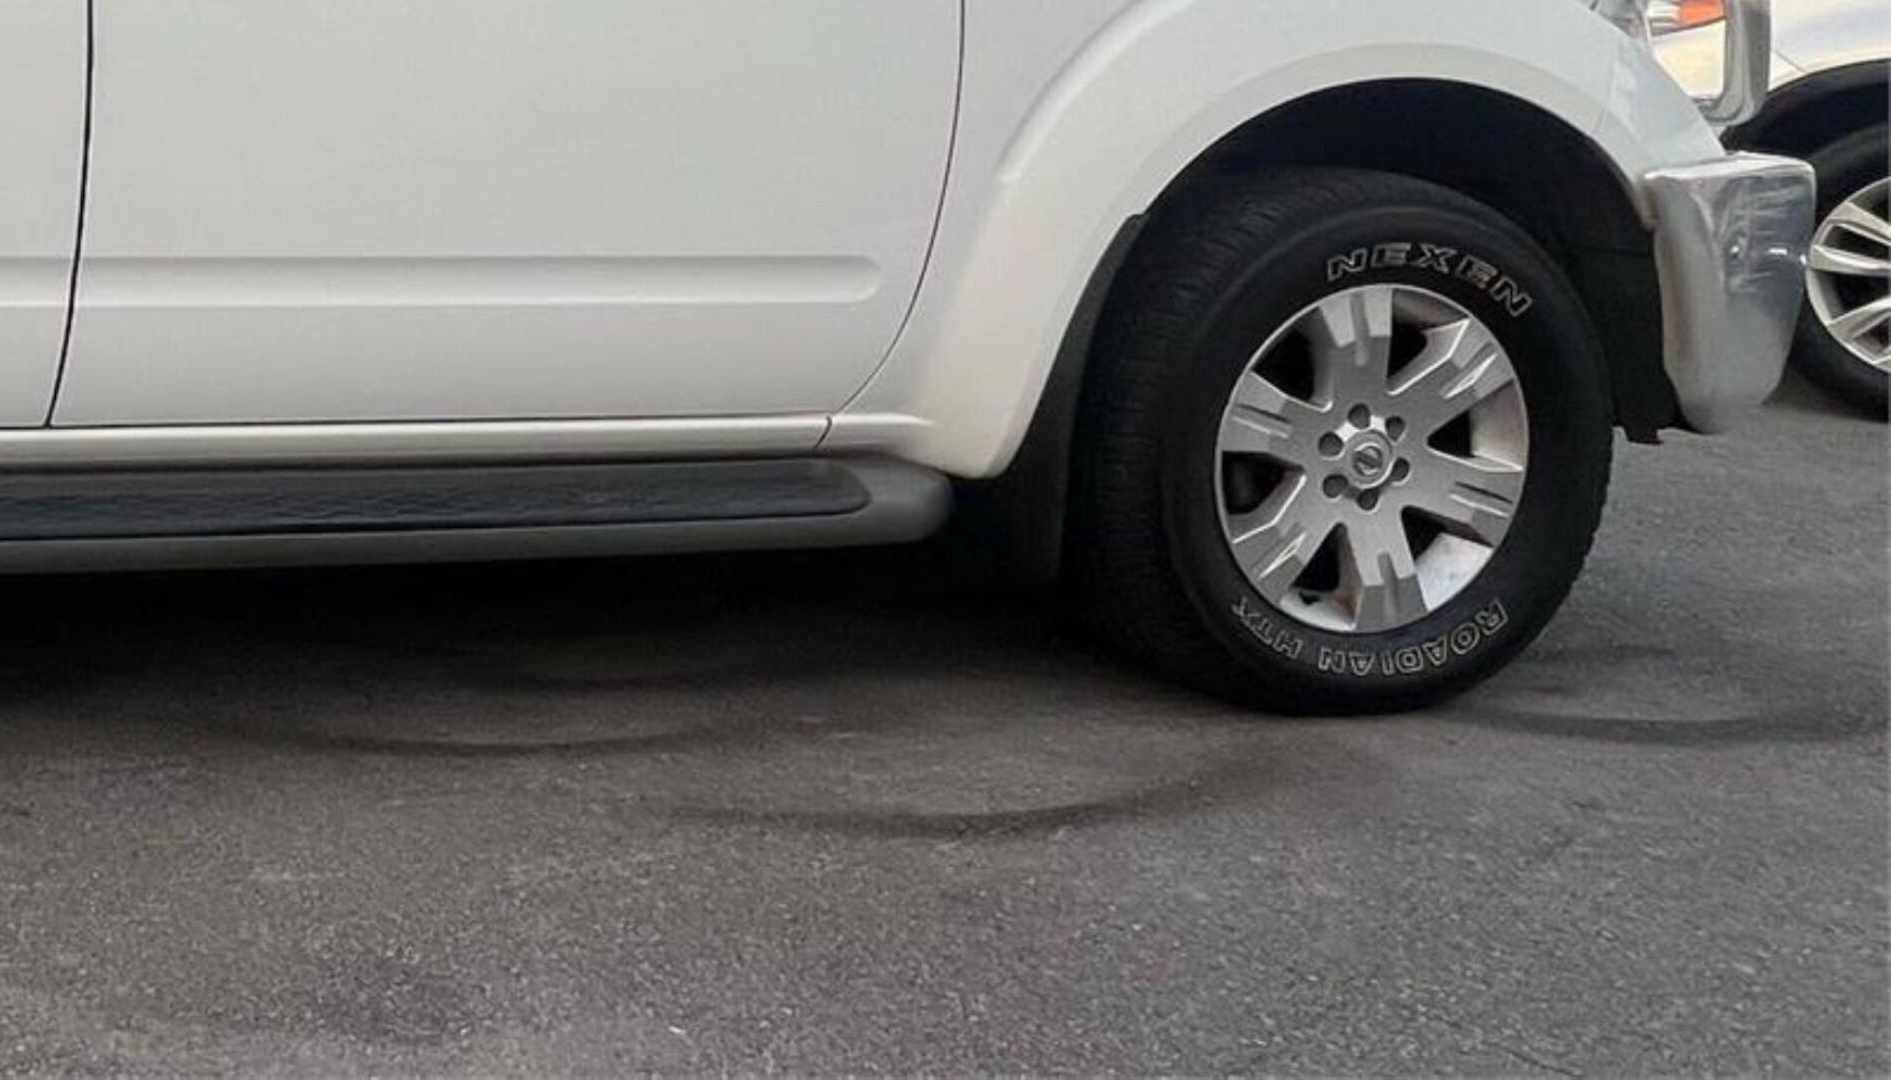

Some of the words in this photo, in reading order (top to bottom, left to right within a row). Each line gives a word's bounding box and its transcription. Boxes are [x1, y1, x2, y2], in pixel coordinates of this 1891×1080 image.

[1327, 242, 1533, 318] NEXEN
[1231, 597, 1304, 659] HTX
[1318, 599, 1510, 676] ROADIAN
